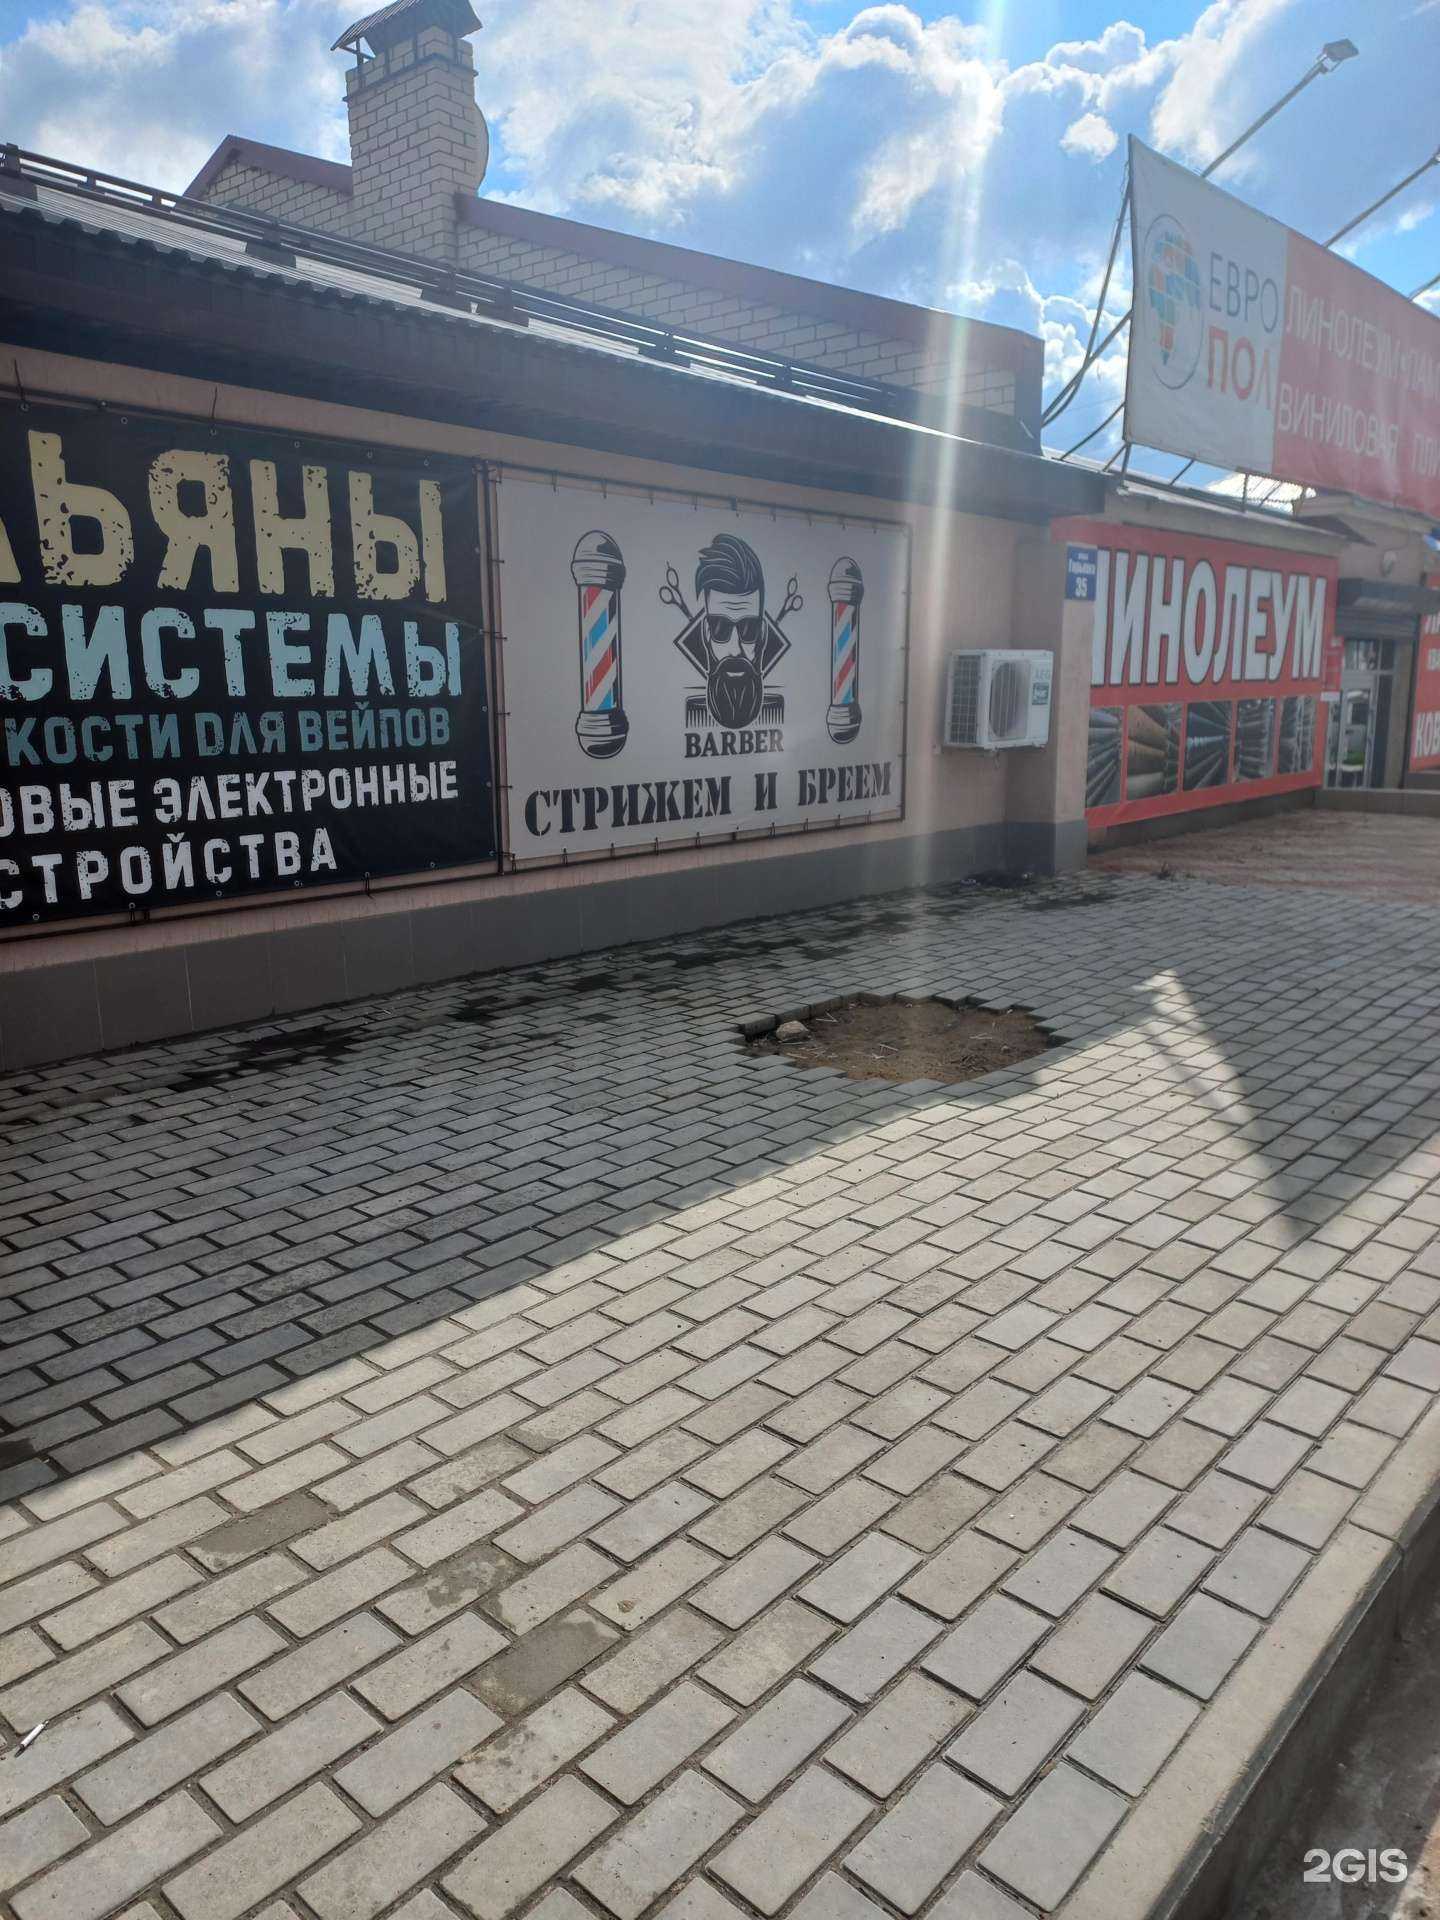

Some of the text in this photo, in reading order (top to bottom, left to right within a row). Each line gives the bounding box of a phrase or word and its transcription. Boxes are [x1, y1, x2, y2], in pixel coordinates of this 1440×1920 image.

[1209, 251, 1279, 334] ЕВРО
[1207, 325, 1271, 410] ПОЛ
[0, 429, 447, 603] ЬЯНЫ
[1075, 576, 1088, 598] 35
[0, 602, 462, 701] СИСТЕМЫ
[5, 713, 181, 767] КОСТИ
[298, 701, 451, 753] ВЕЙПОВ
[684, 729, 785, 759] BARBER
[154, 760, 459, 825] ЭЛЕКТРОННЫЕ
[524, 761, 892, 837] СТРИЖЕМ И БРЕЕМ
